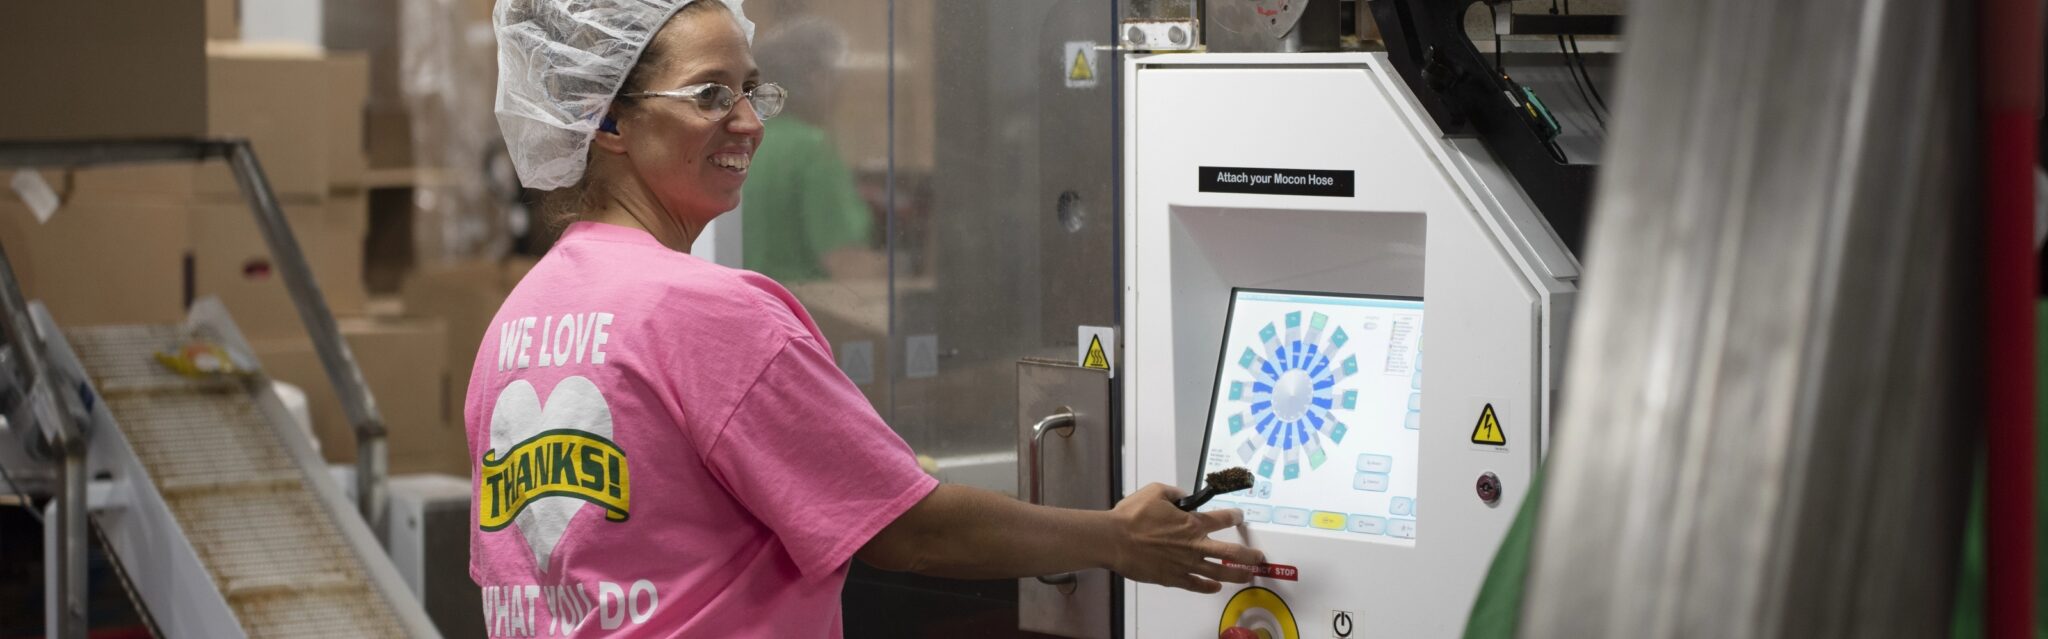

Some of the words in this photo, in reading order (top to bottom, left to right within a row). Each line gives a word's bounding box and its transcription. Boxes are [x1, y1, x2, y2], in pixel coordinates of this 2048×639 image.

[1216, 171, 1248, 183] Attach
[1250, 174, 1272, 186] your
[1274, 173, 1306, 185] Mocon
[1308, 174, 1334, 186] Hose
[498, 316, 537, 373] WE
[538, 311, 615, 367] LOVE
[486, 441, 622, 519] THANKS!
[1275, 567, 1295, 576] STOP
[543, 582, 593, 637] YOU
[599, 579, 659, 630] DO
